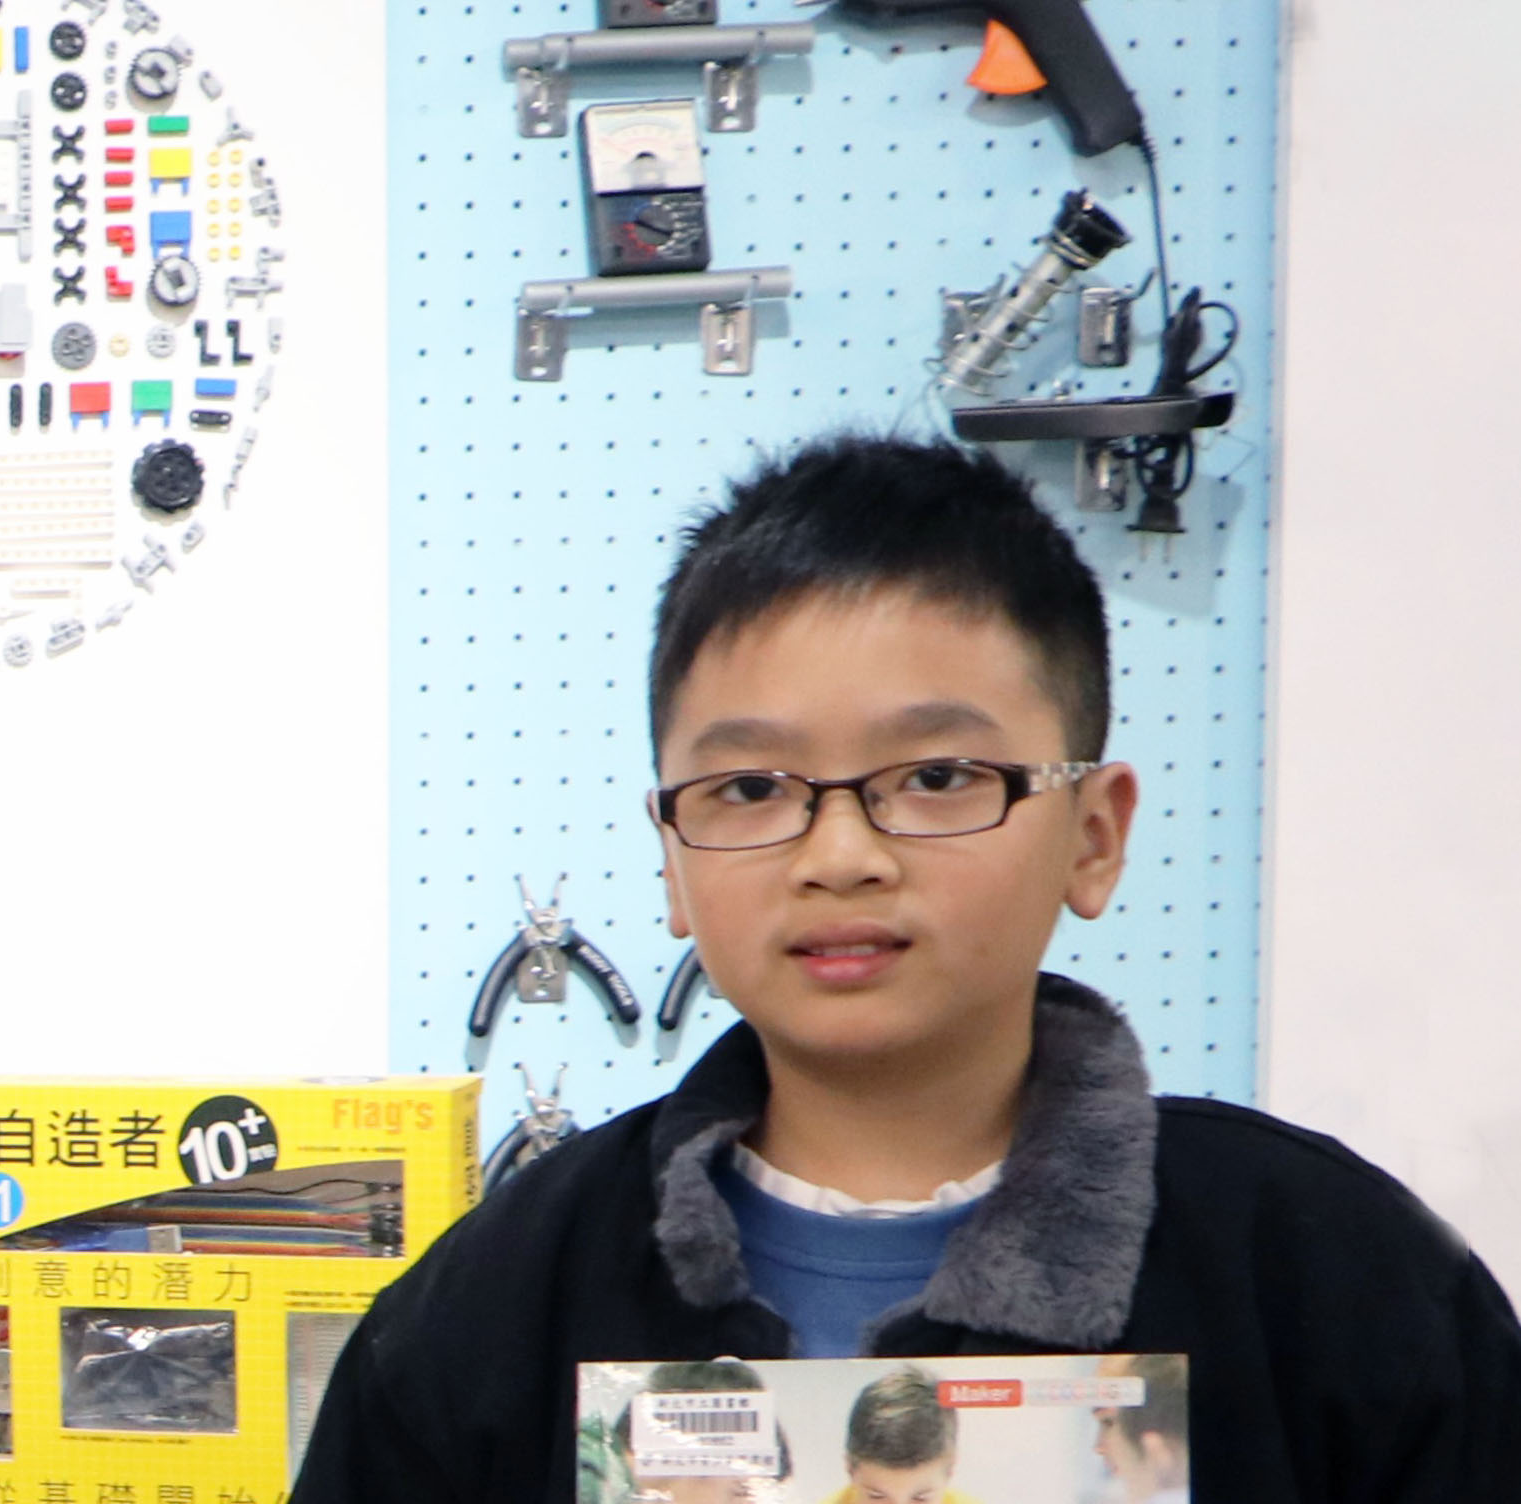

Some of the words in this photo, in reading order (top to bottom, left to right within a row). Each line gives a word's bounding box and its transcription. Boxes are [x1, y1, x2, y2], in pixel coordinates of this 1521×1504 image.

[333, 1098, 435, 1135] Flag's
[178, 1107, 267, 1184] 10+
[949, 1384, 1014, 1402] Maker
